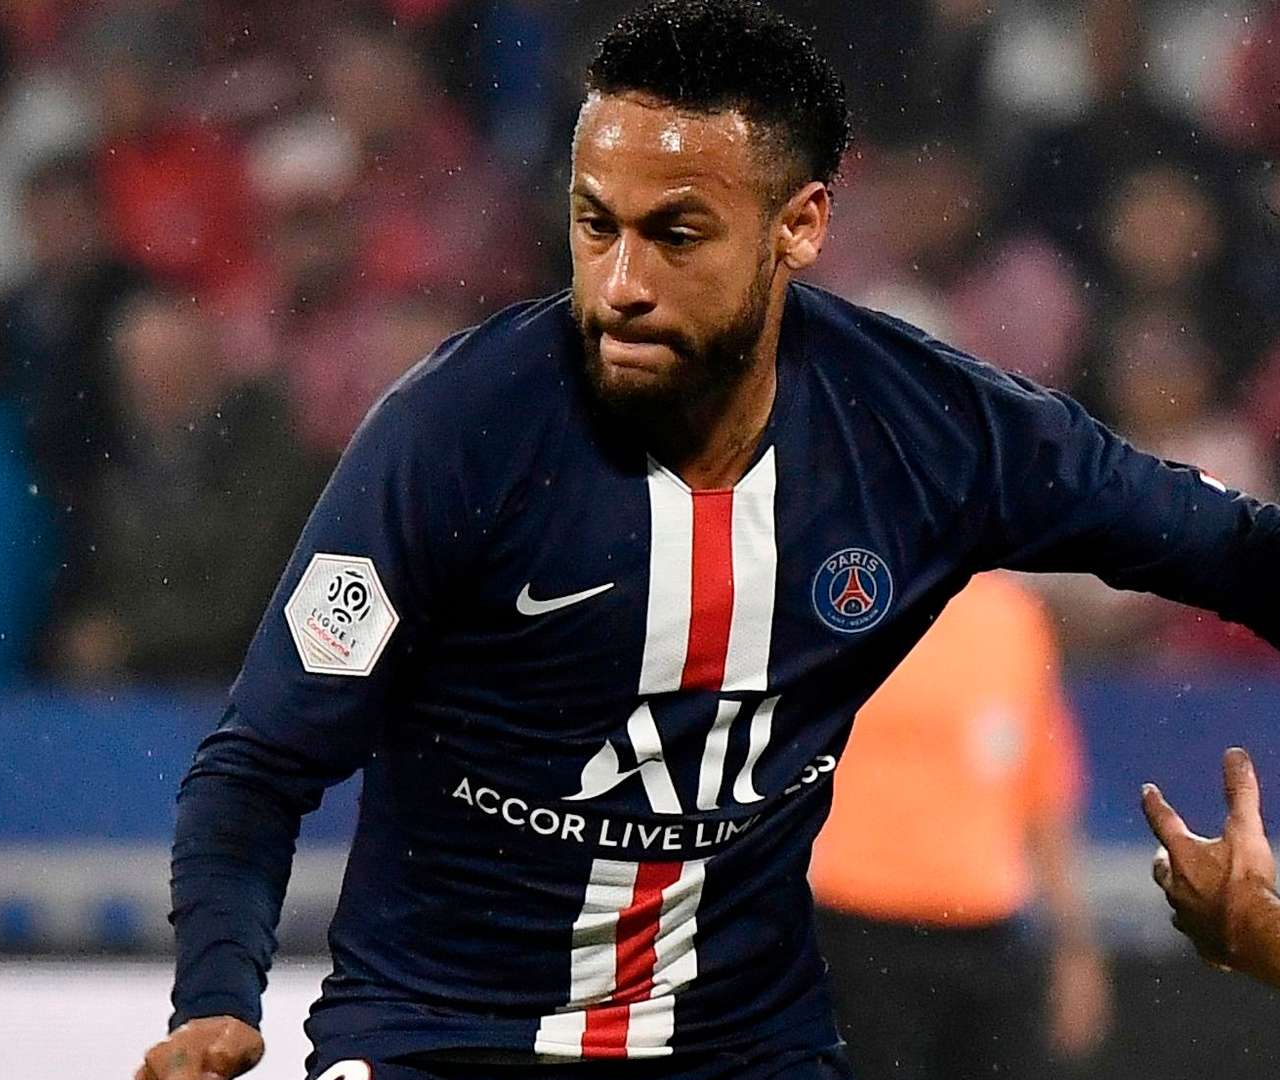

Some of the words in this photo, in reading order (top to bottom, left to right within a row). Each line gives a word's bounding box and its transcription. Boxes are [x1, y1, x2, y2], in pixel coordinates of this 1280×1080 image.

[826, 552, 879, 575] PARIS
[310, 607, 346, 641] LIGUE
[451, 777, 586, 843] ACCOR
[598, 818, 683, 851] LIVE
